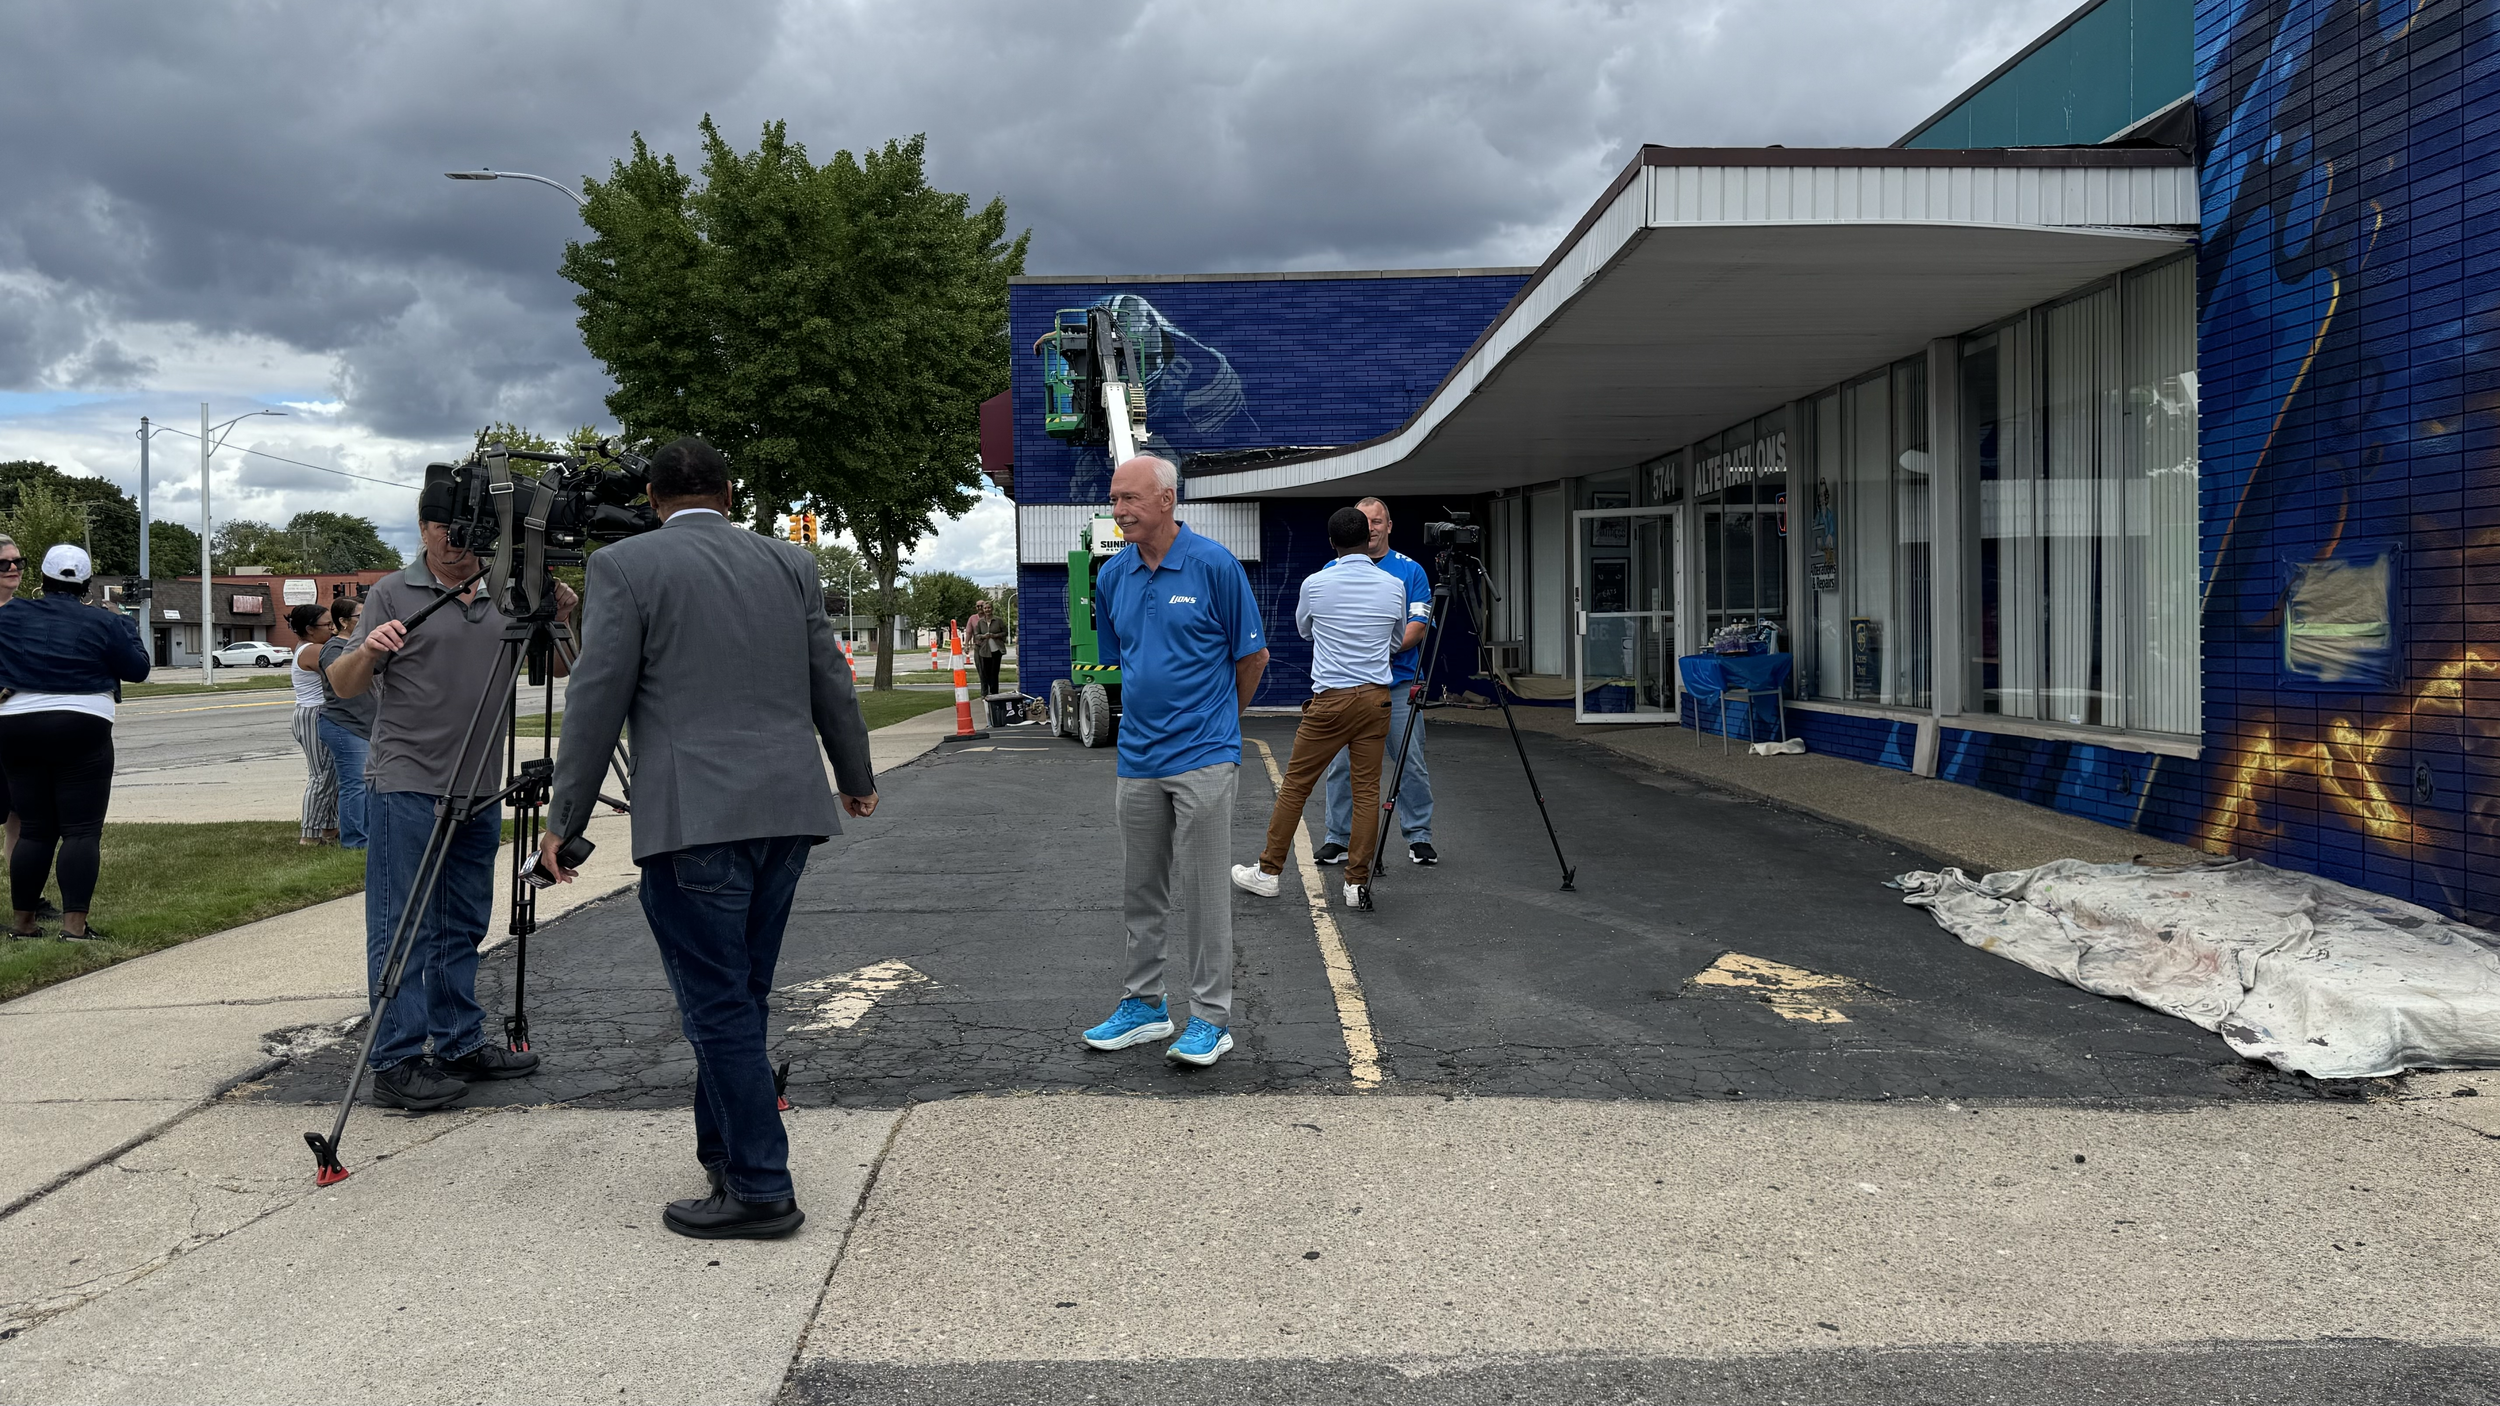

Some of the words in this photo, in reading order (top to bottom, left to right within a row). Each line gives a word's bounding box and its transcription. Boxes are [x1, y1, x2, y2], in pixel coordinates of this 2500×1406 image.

[1694, 432, 1787, 497] ALTERATIONS
[1653, 462, 1676, 500] 5741
[1810, 563, 1837, 577] Alterations
[1816, 577, 1835, 592] Repairs
[1169, 594, 1197, 603] LIONS
